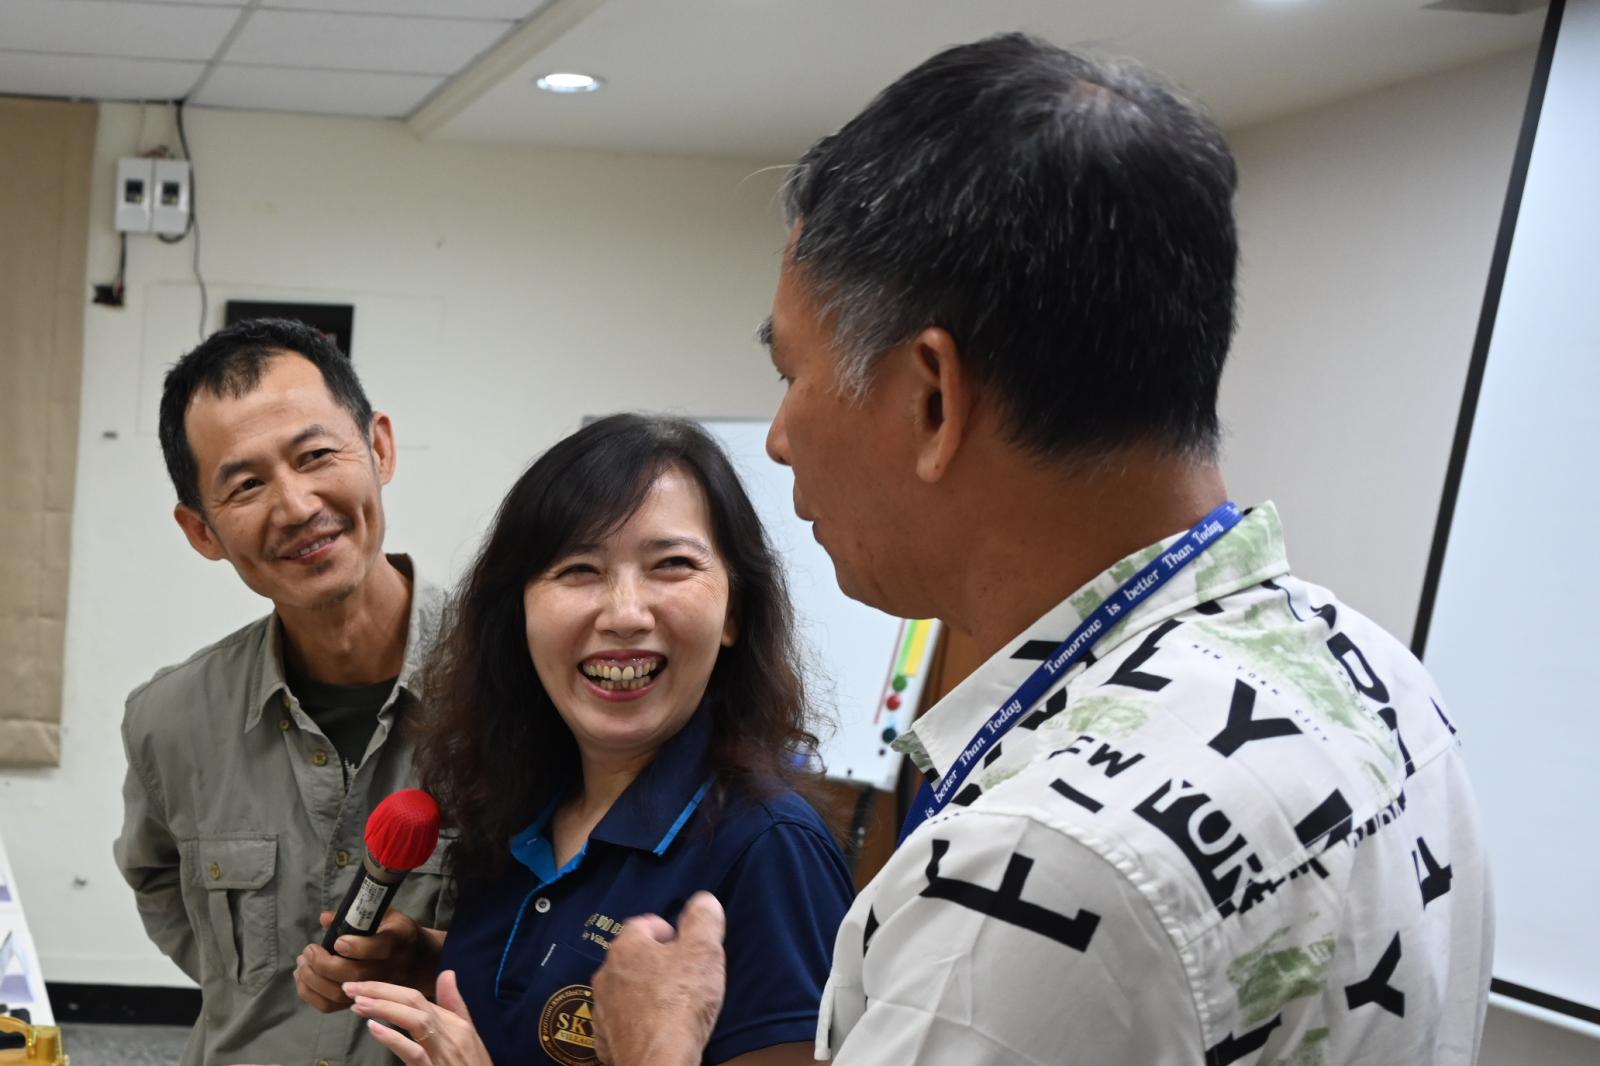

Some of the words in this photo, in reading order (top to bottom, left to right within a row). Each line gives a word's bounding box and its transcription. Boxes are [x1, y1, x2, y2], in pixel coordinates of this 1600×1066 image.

[1043, 617, 1103, 676] Tomorrow
[1104, 602, 1122, 617] is
[1123, 568, 1160, 602] better
[1161, 542, 1195, 571] Than
[1191, 519, 1224, 545] Today
[933, 769, 959, 803] better
[959, 736, 987, 768] Than
[985, 699, 1023, 735] Today
